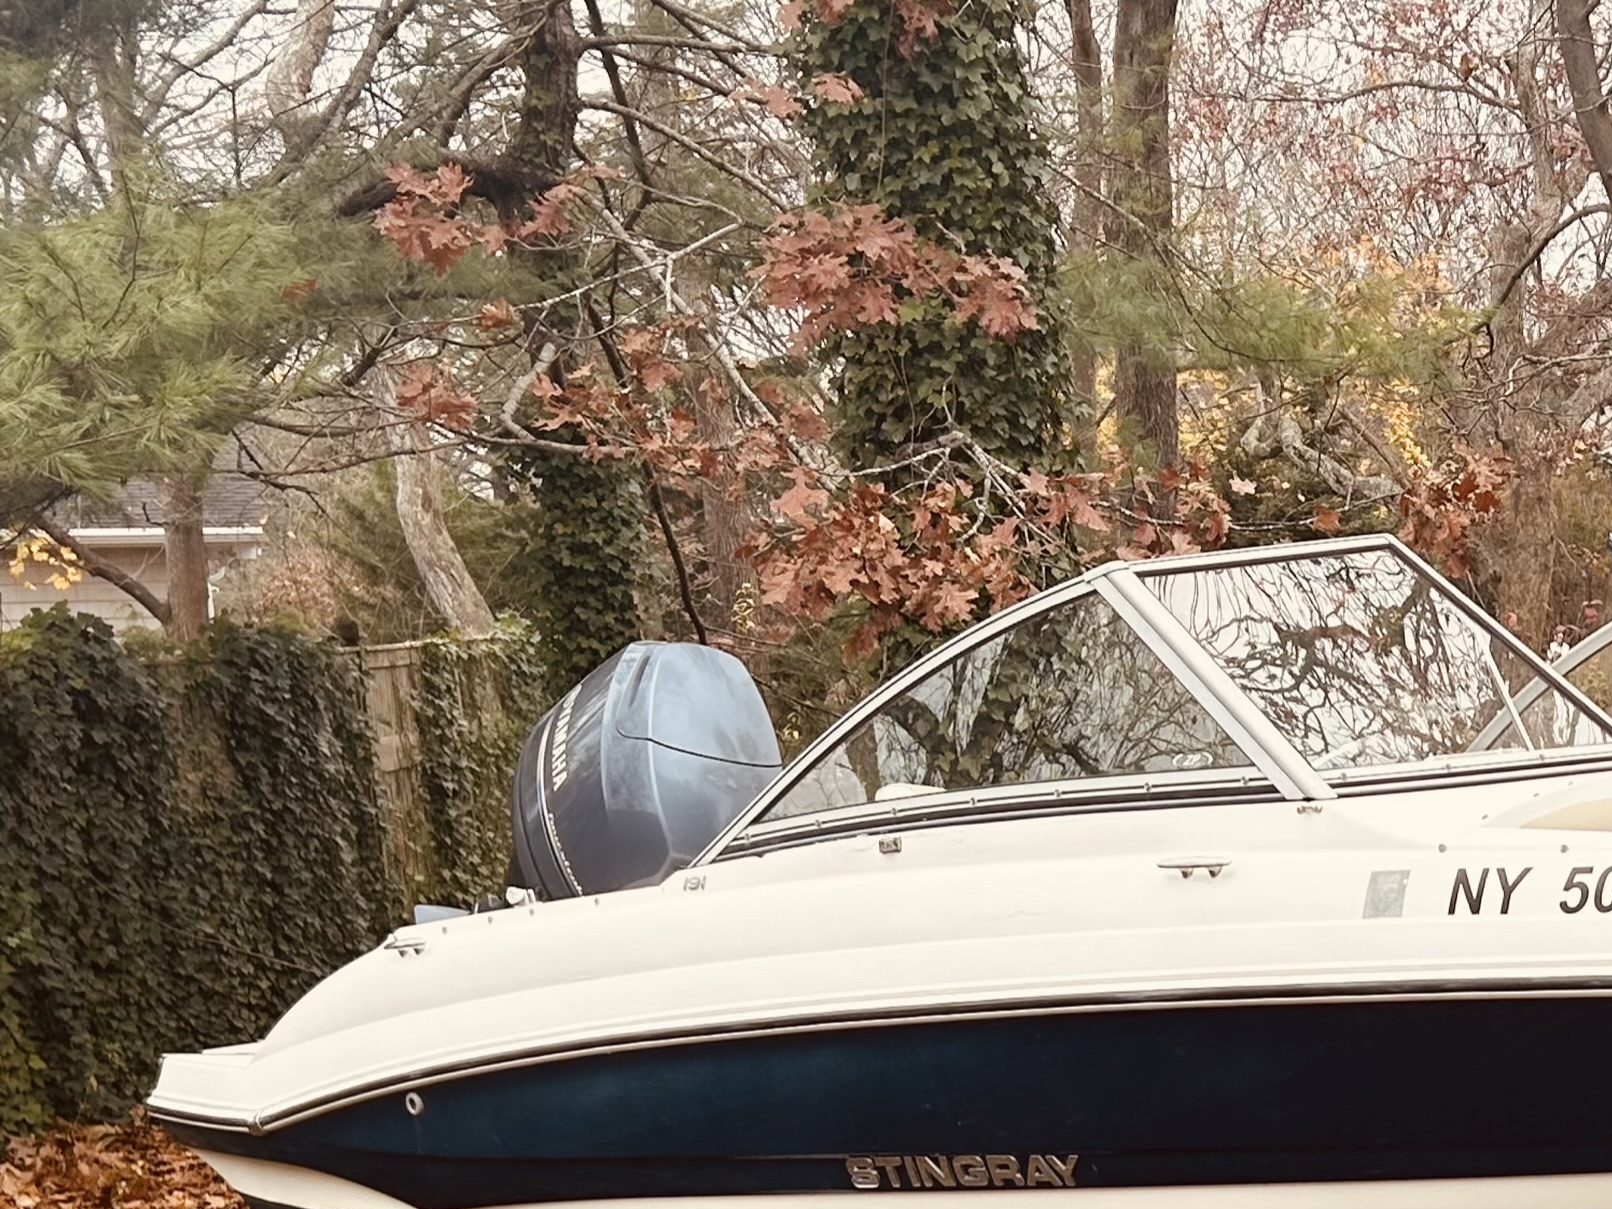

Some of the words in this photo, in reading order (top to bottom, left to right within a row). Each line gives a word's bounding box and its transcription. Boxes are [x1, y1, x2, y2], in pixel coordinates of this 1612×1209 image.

[552, 701, 575, 791] YAMAHA
[1448, 866, 1534, 915] NY
[846, 1154, 1079, 1189] STINGRAY
